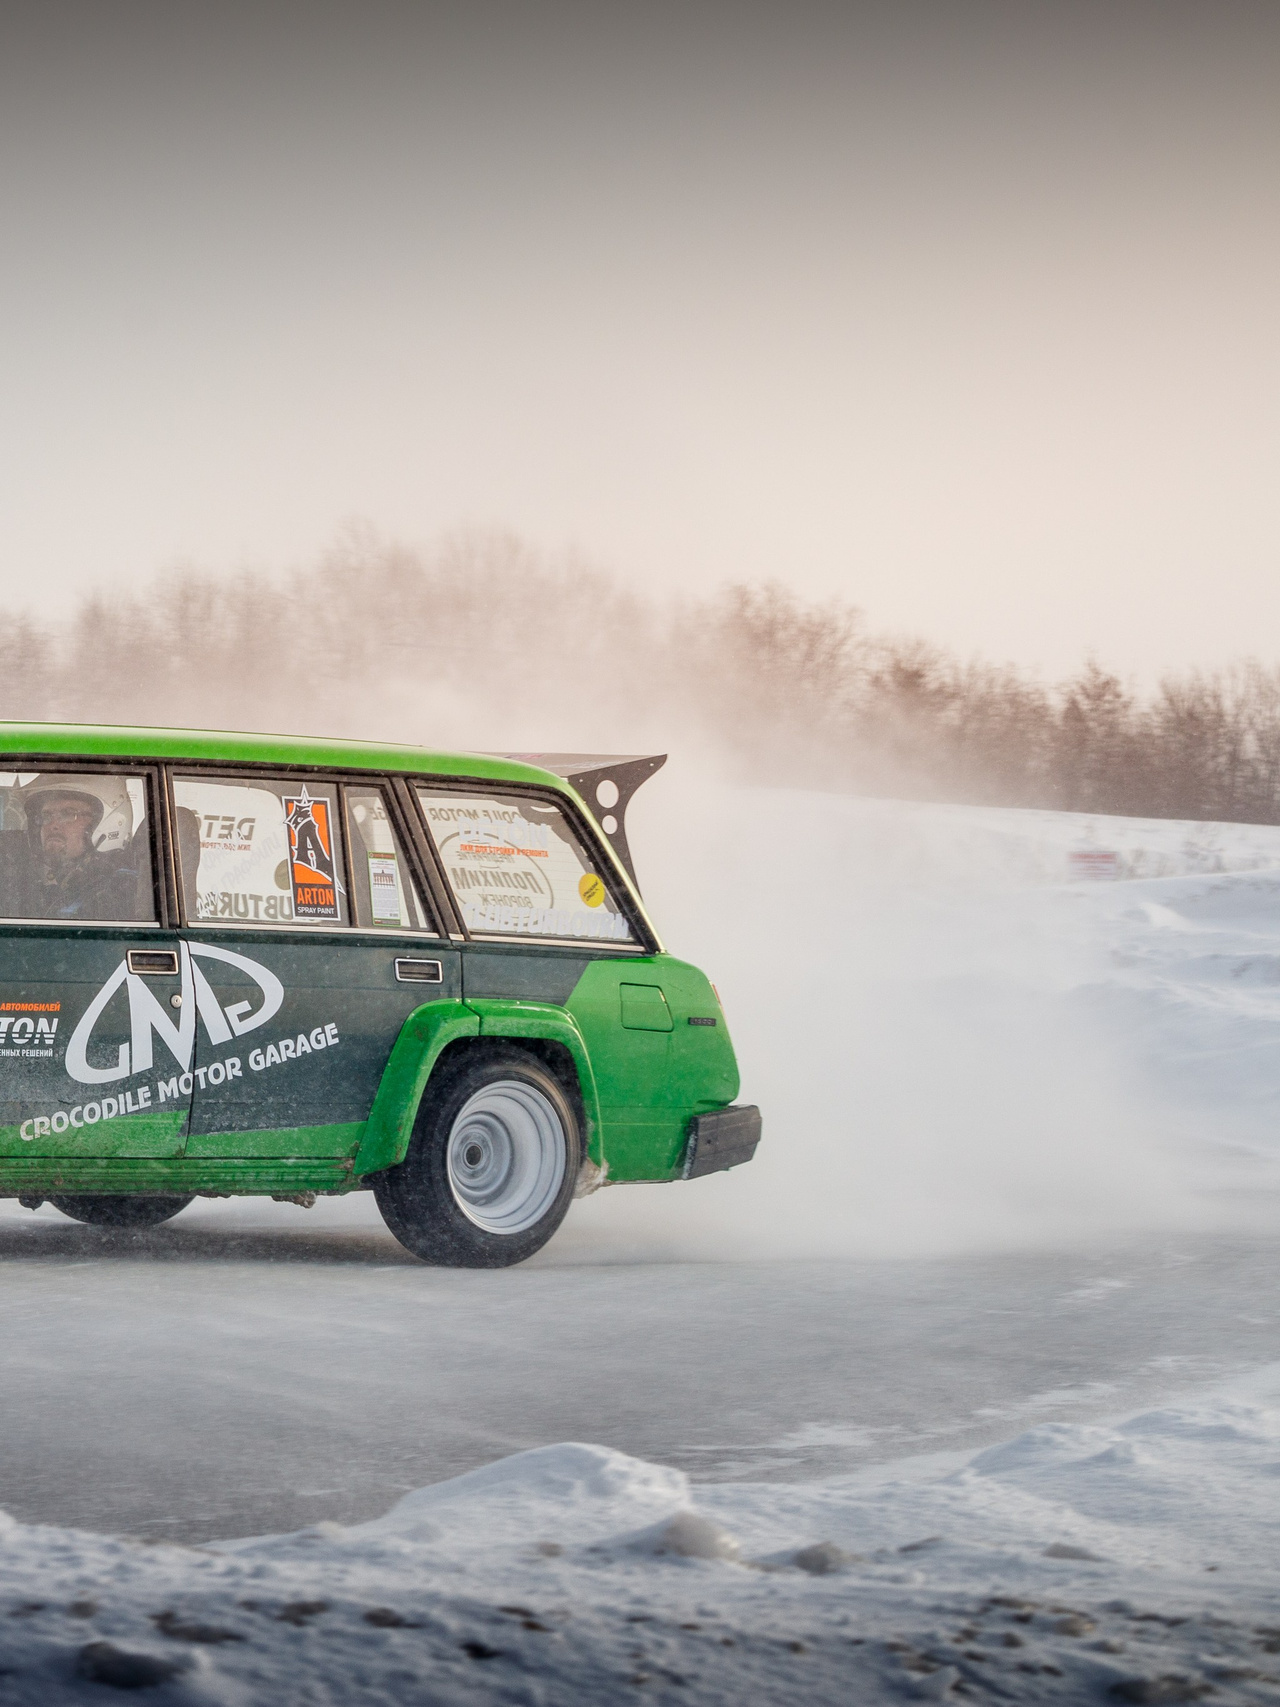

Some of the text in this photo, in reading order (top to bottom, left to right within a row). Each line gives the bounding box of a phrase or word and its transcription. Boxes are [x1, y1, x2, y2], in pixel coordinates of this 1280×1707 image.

[297, 887, 335, 906] ARTON
[297, 906, 335, 915] SPRAY PAINT
[0, 1001, 61, 1012] АВТОМОБИЛЕЙ
[21, 1047, 53, 1057] РЕШЕНИЙ
[19, 1022, 340, 1141] CROCODILE MOTOR GARAGE
